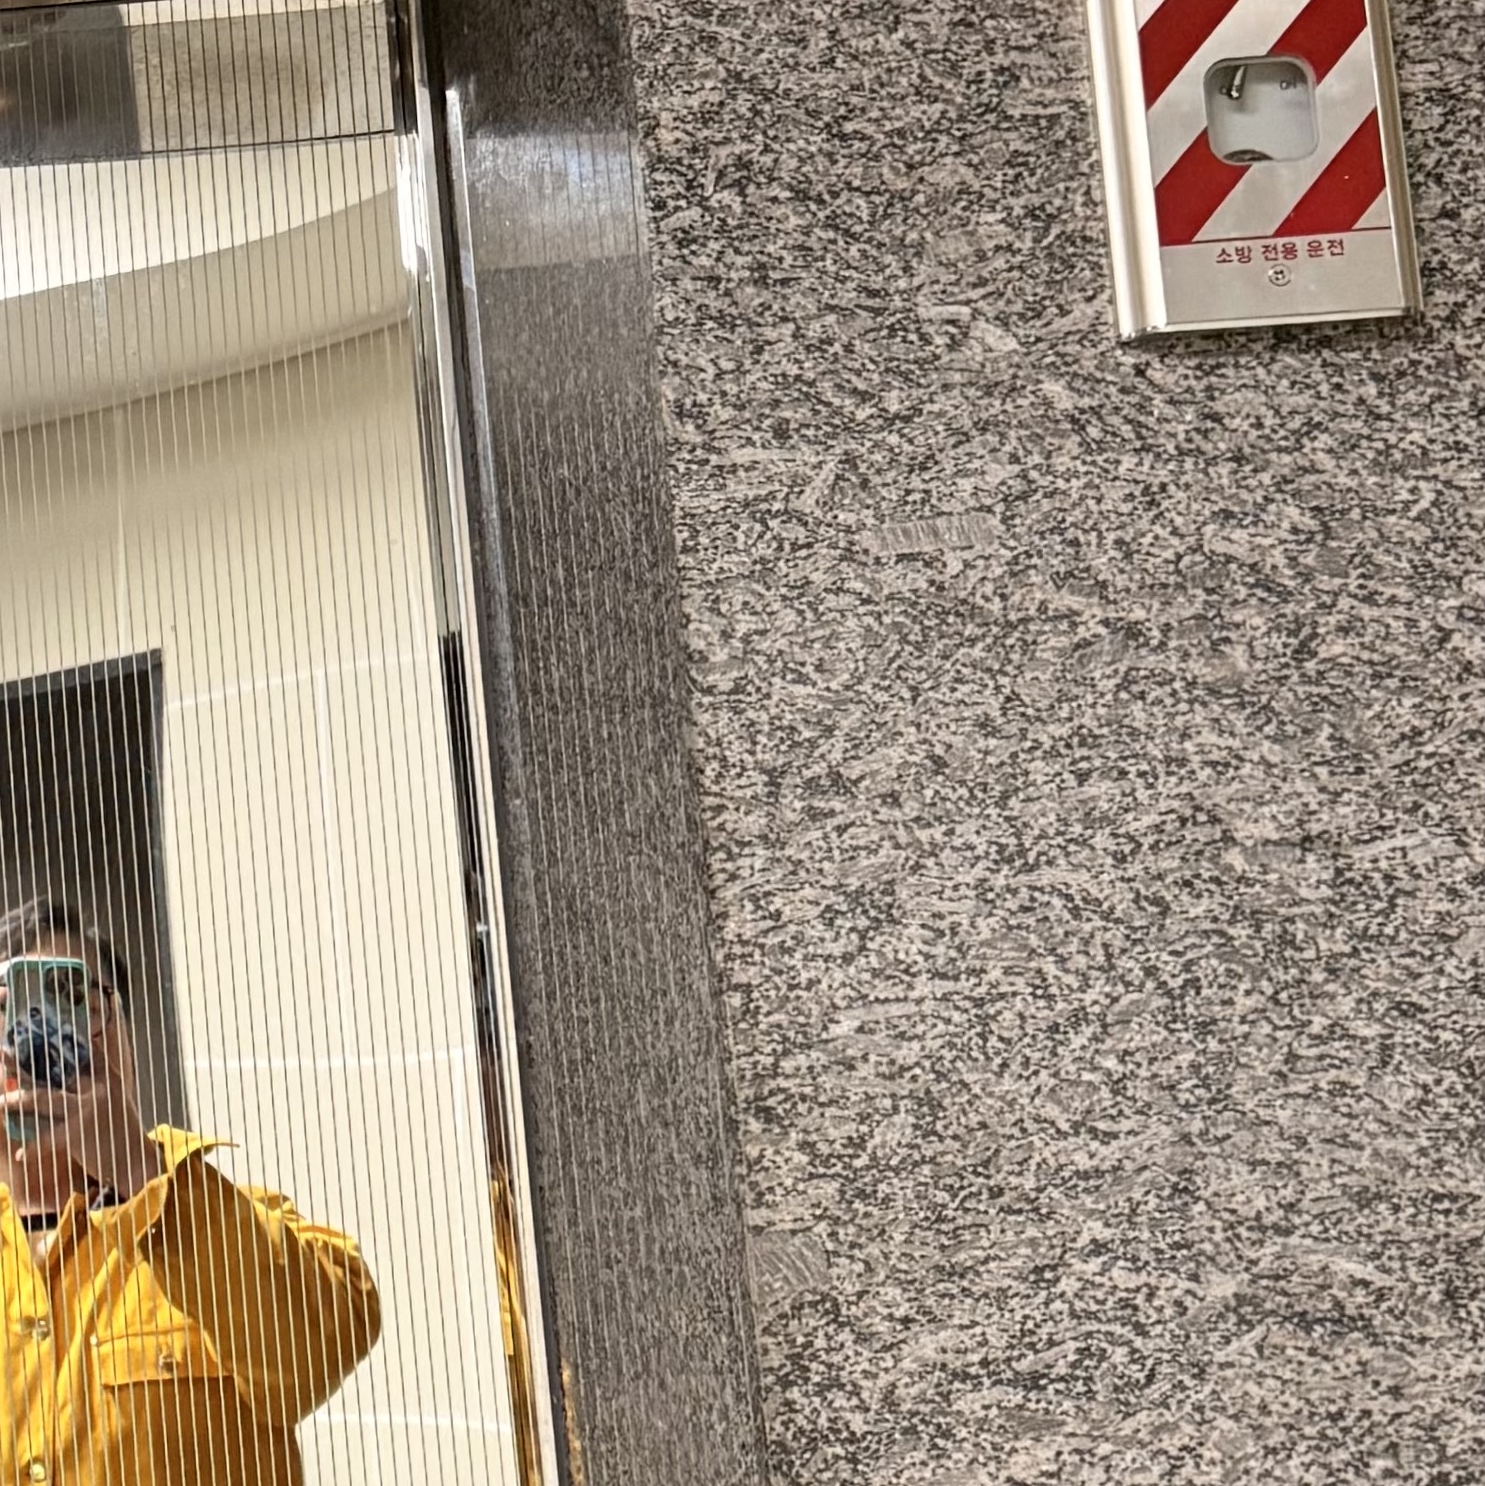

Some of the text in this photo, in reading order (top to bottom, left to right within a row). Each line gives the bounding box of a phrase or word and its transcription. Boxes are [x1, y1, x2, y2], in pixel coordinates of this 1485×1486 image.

[1216, 238, 1345, 264] 소방 전용 운전
